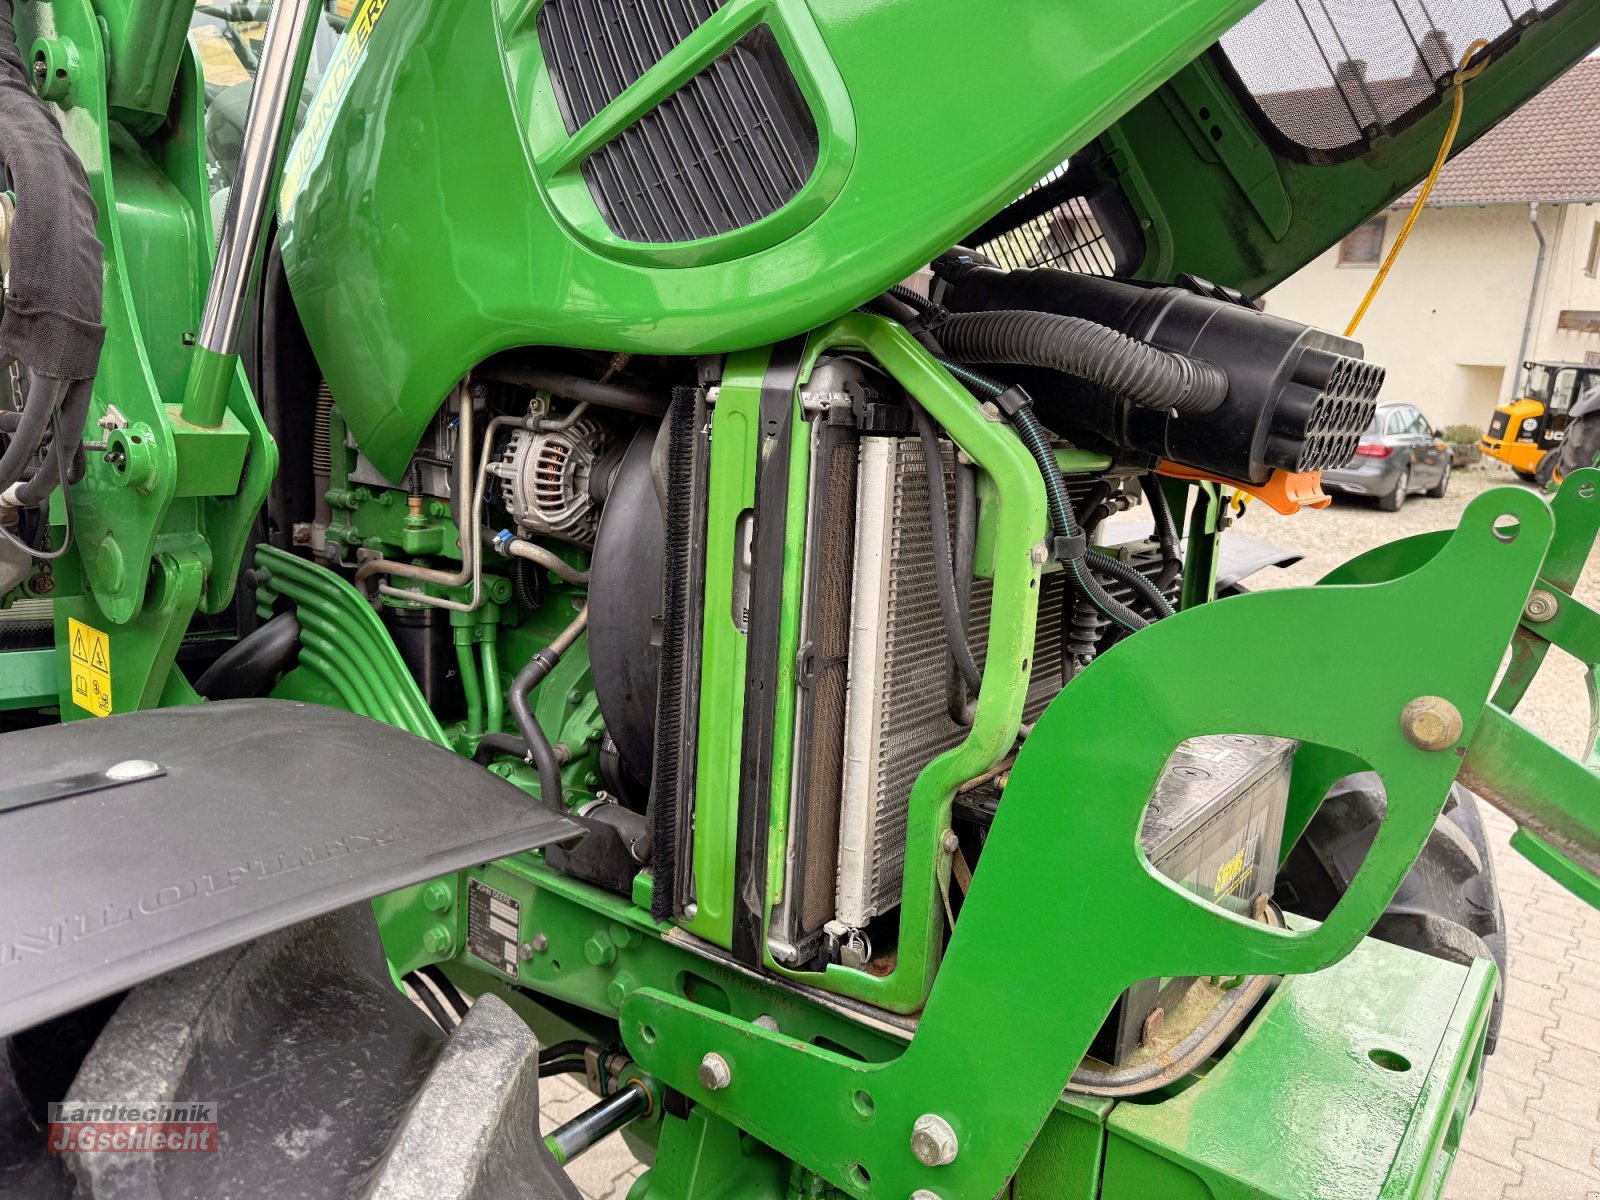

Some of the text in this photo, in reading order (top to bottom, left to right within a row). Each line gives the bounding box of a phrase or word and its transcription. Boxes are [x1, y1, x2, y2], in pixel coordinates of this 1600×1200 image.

[297, 0, 385, 186] JOHN DEER
[1544, 431, 1564, 441] JC
